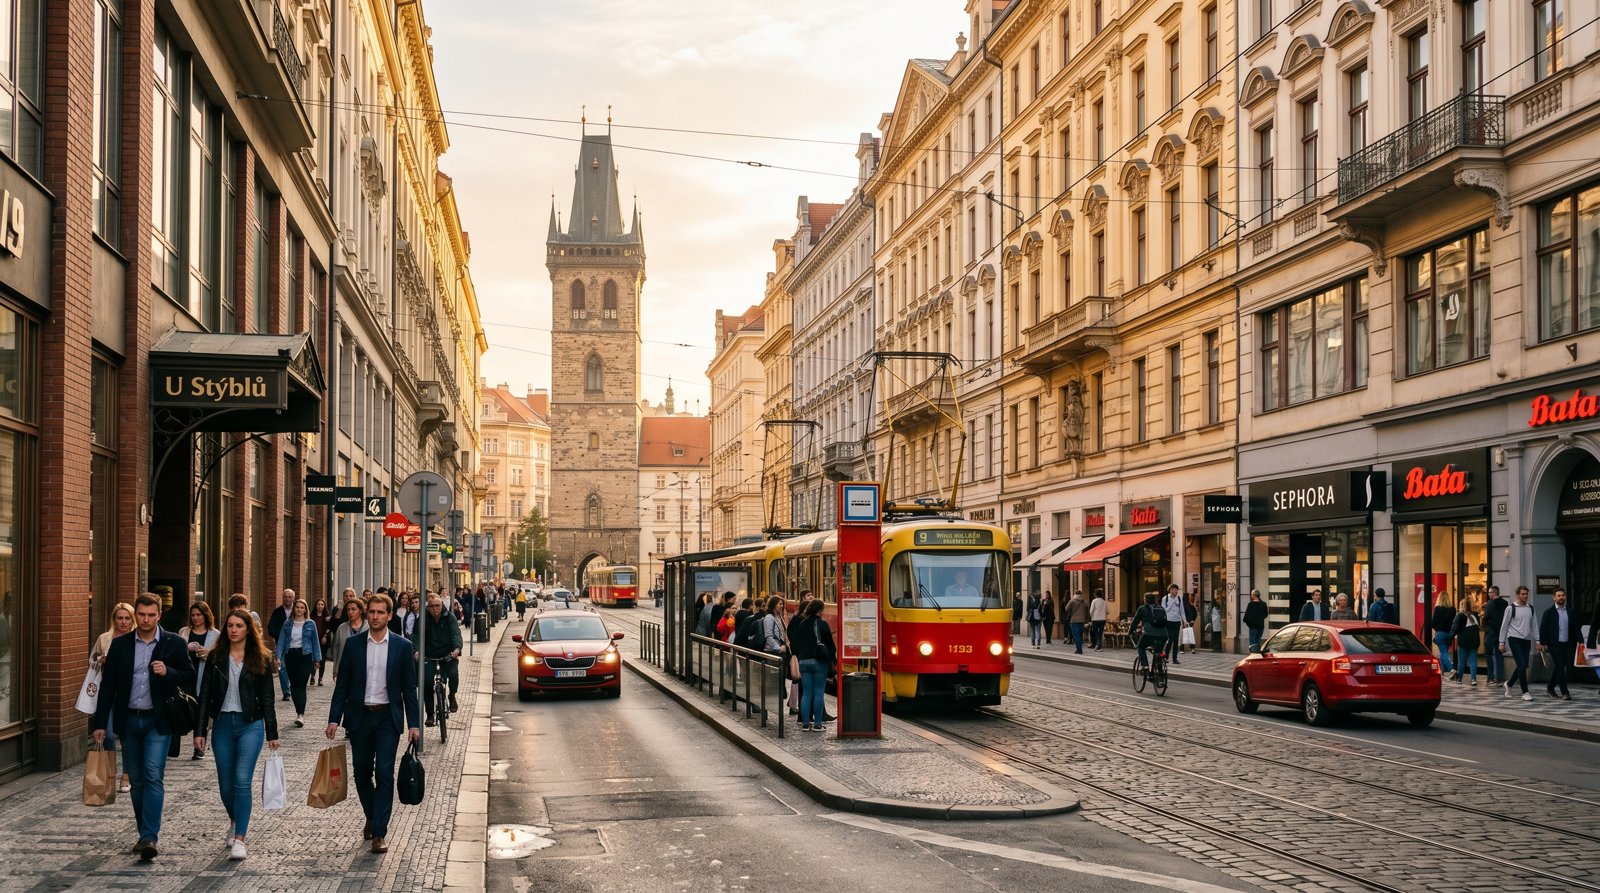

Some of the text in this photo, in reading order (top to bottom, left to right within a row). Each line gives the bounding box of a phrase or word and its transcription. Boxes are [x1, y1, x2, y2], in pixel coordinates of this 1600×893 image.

[166, 376, 266, 401] U Stýblů
[1273, 485, 1335, 511] SEPHORA
[919, 532, 928, 543] 9
